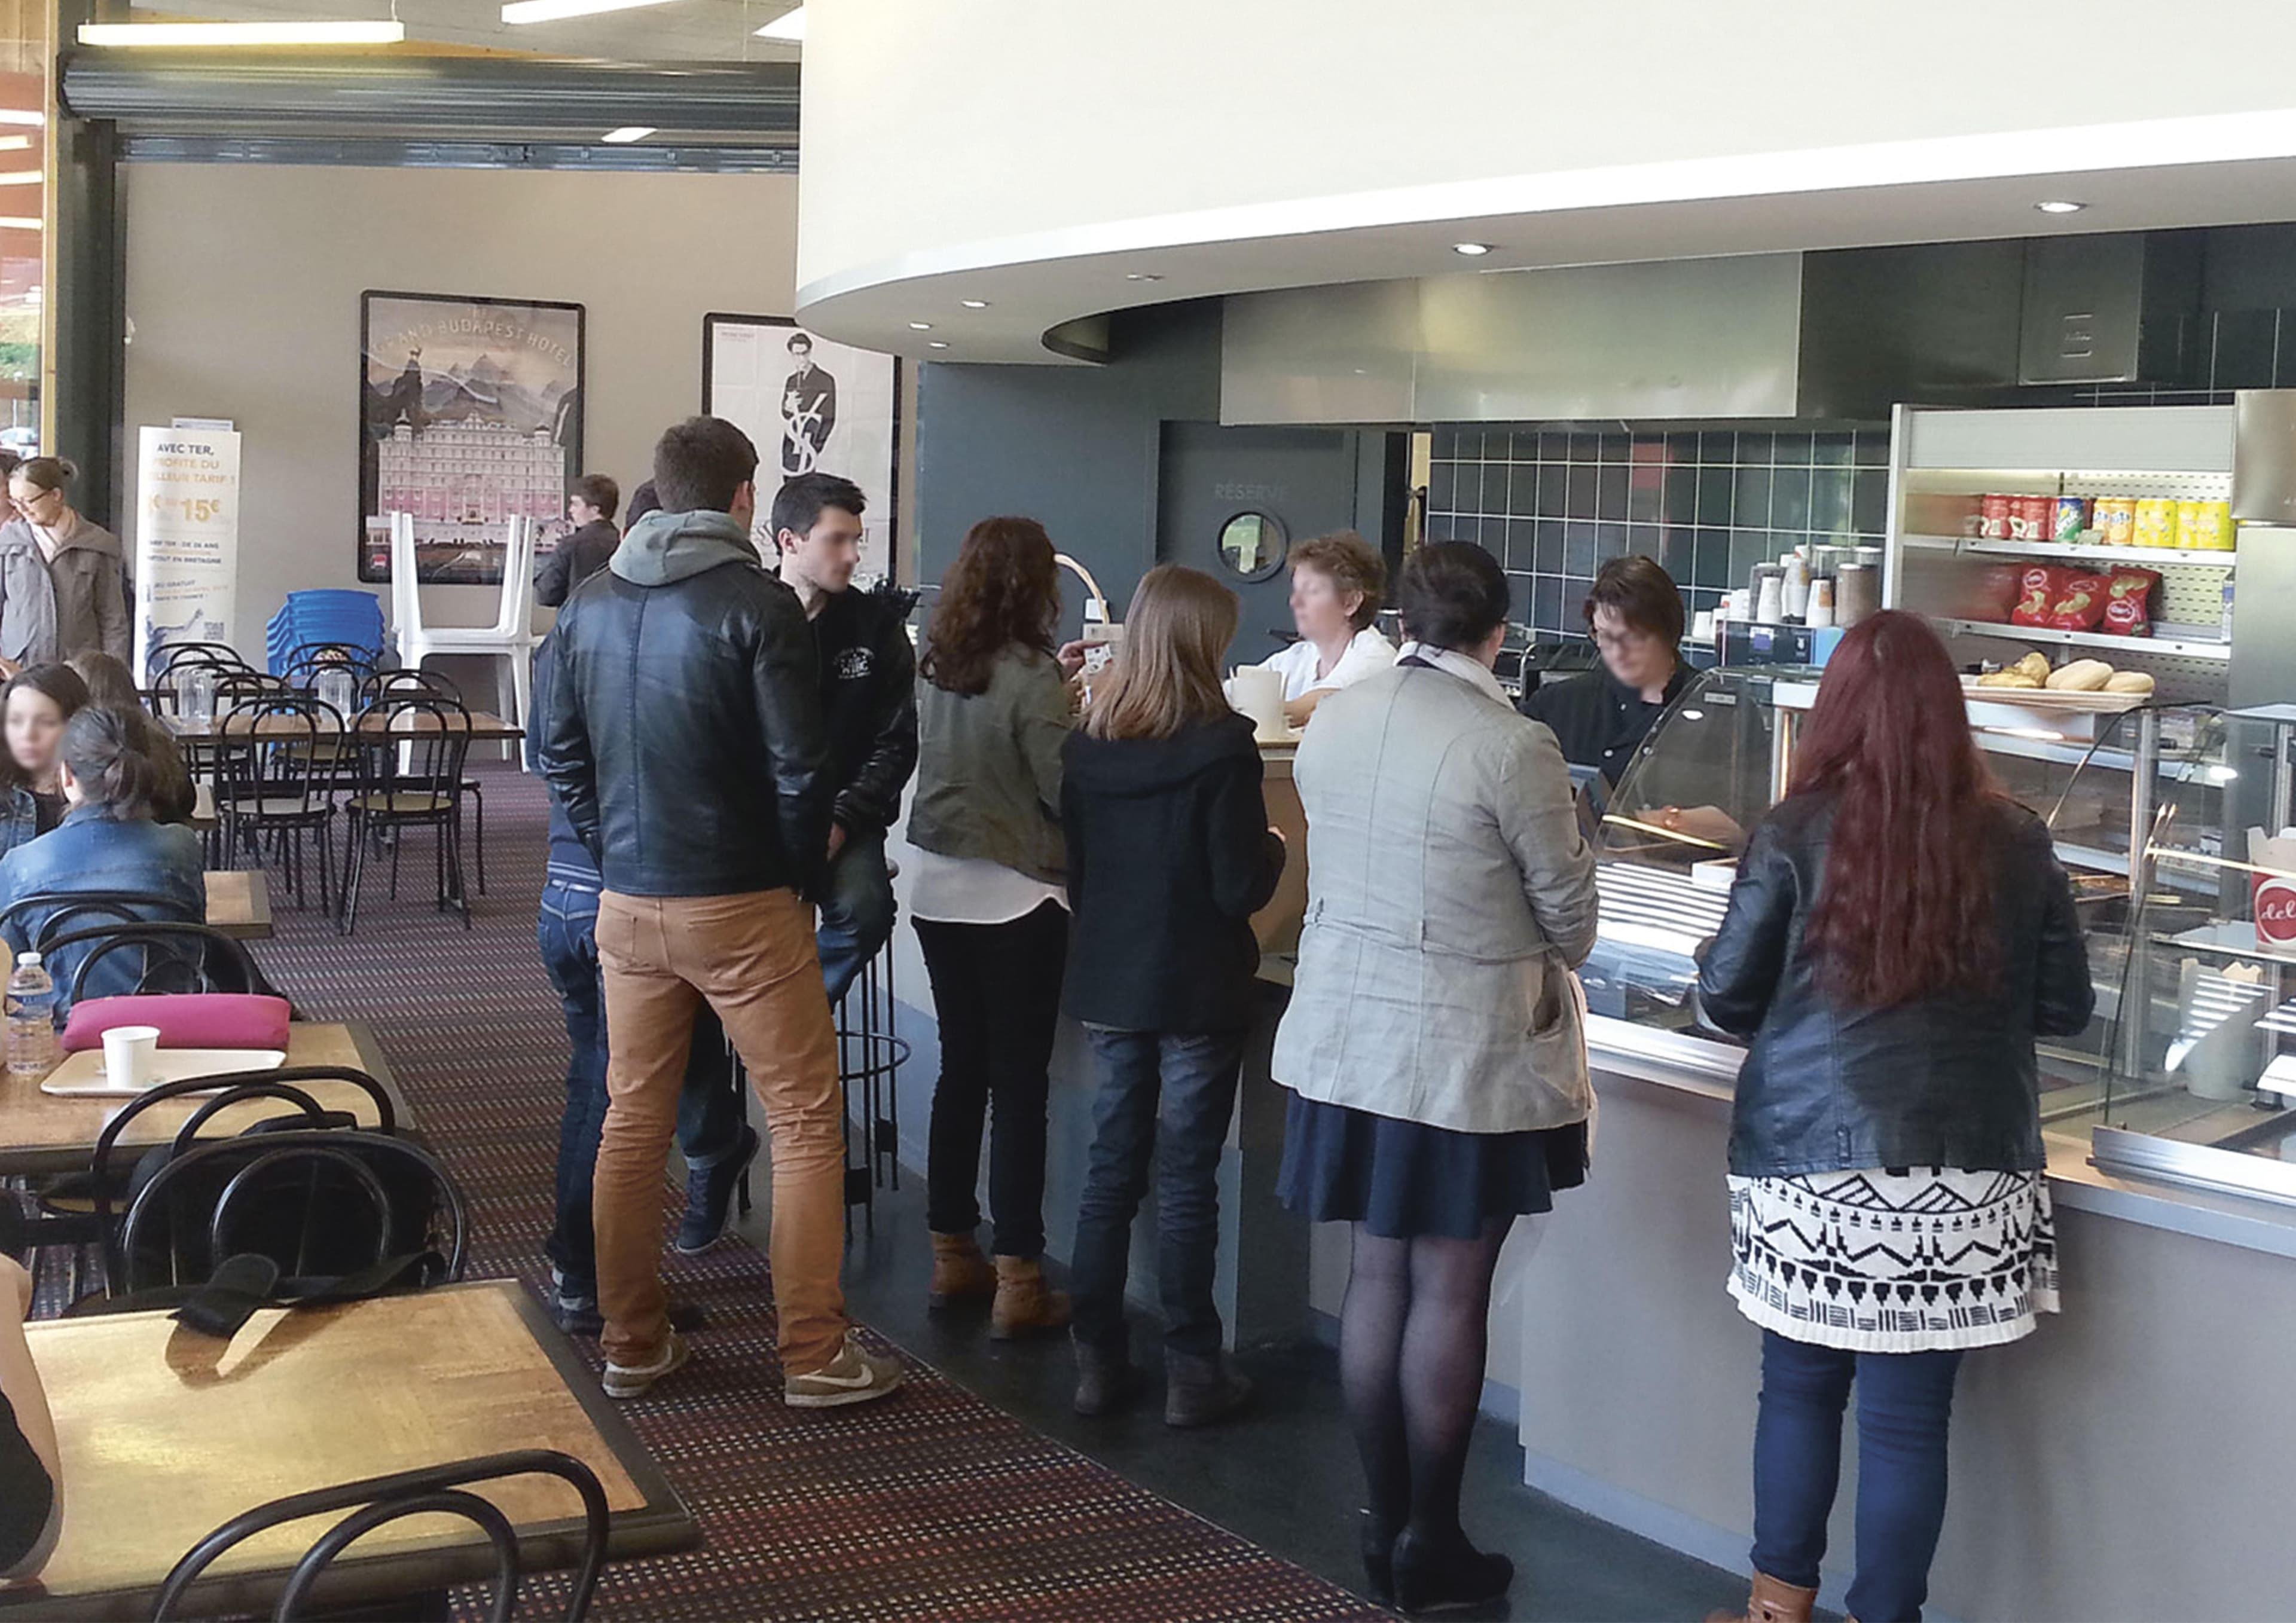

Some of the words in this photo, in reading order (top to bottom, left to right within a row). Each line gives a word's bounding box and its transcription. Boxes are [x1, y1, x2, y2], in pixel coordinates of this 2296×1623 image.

[438, 318, 524, 340] BUDAPEST
[527, 332, 575, 366] HOTEL
[157, 444, 185, 454] AVEC
[201, 460, 220, 469] DU
